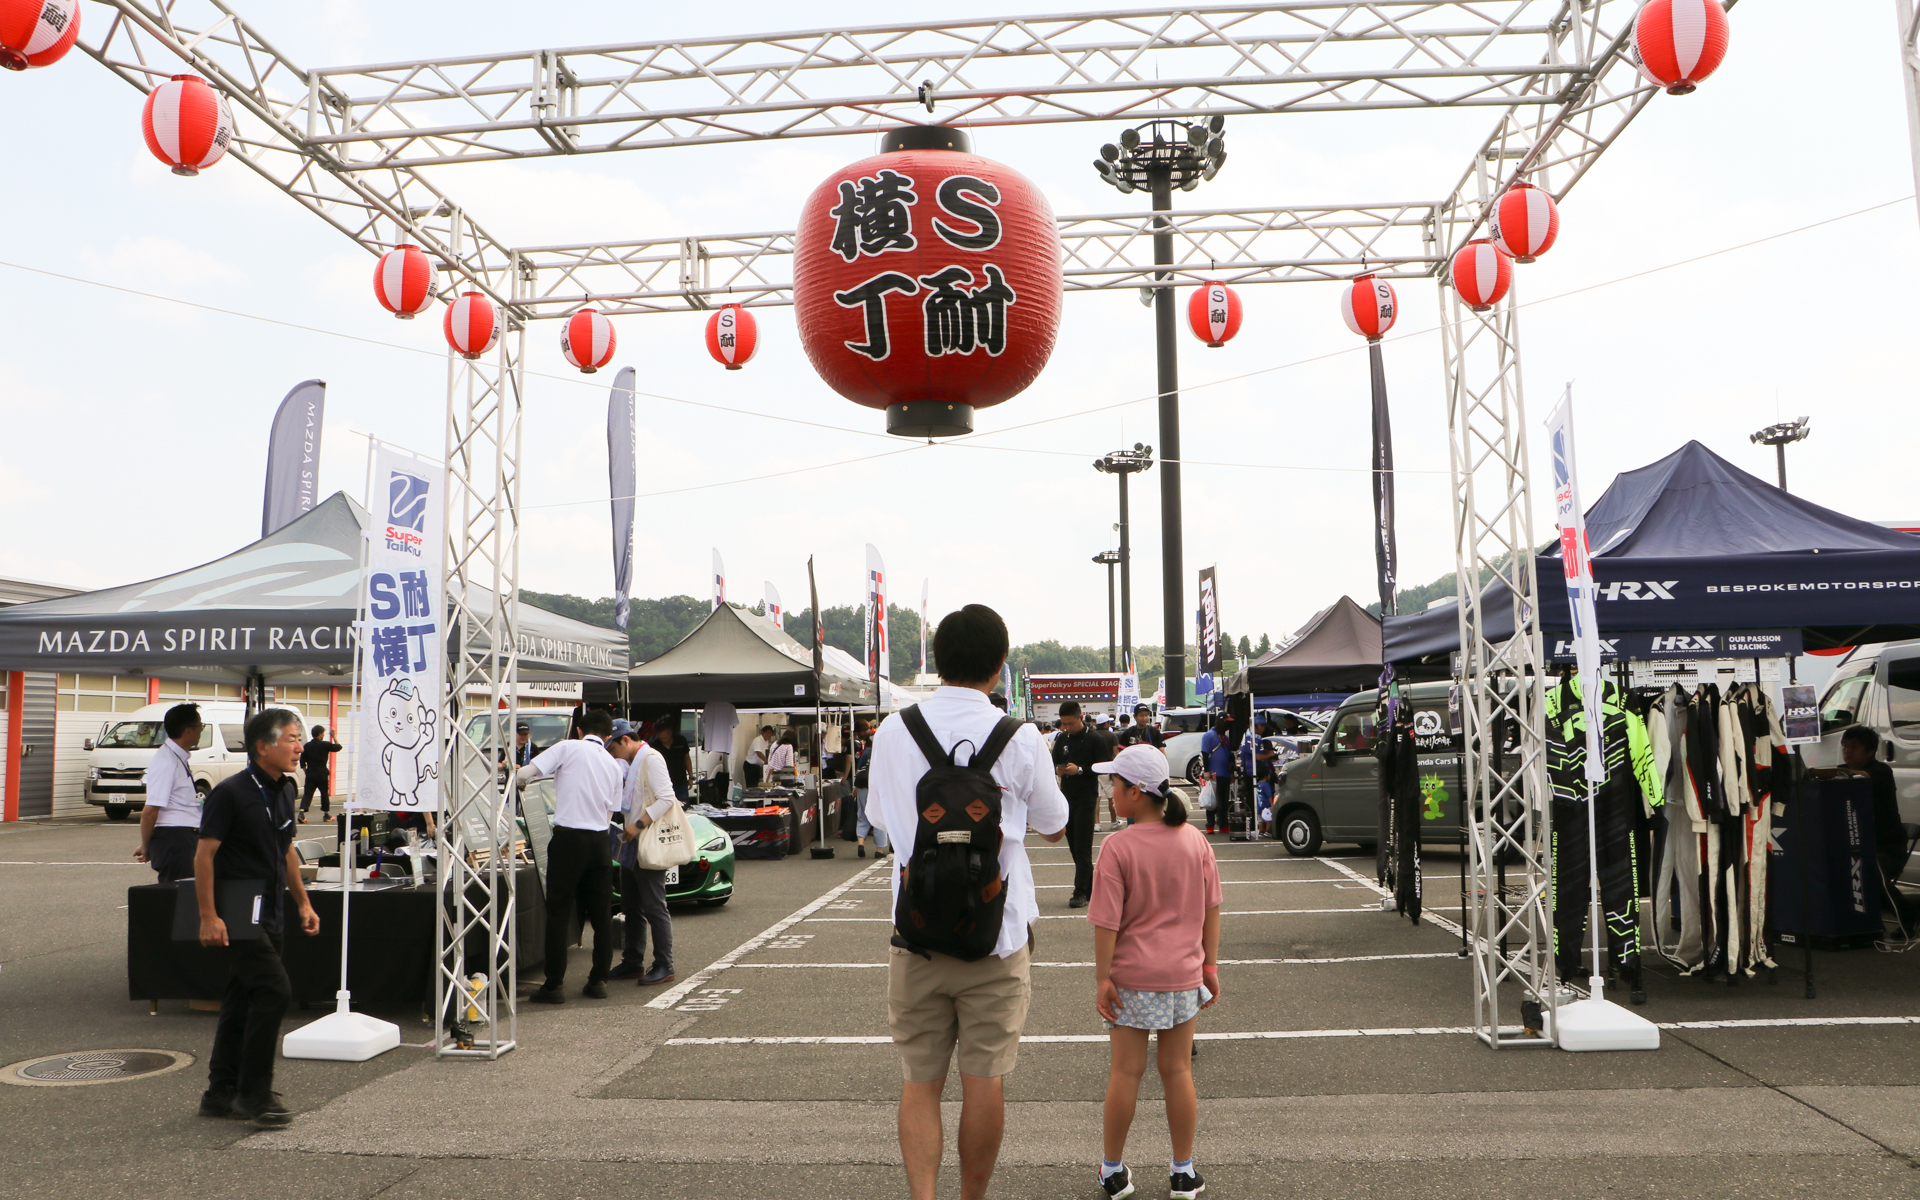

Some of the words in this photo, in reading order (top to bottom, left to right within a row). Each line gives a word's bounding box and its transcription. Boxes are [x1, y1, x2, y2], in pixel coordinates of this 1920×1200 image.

[829, 169, 920, 361] 横丁
[931, 175, 1017, 357] S耐
[1211, 290, 1226, 324] S耐
[720, 314, 736, 348] S耐
[303, 401, 316, 464] MAZDA
[301, 470, 313, 512] SPIRI
[385, 526, 423, 545] Super
[385, 538, 422, 557] Taikyu
[370, 569, 430, 620] S耐
[1593, 580, 1680, 601] HRX
[1707, 580, 1920, 593] BESPOKEMOTORSPOR
[38, 629, 151, 654] MAZDA
[163, 627, 256, 652] SPIRIT
[268, 626, 363, 651] RACIN
[371, 623, 436, 678] 横丁
[496, 630, 537, 657] ADA
[540, 638, 573, 662] SPIRIT
[576, 644, 613, 668] RACING
[1554, 638, 1621, 655] HX
[1651, 635, 1717, 650] HRX
[1738, 643, 1771, 651] RACING.
[1747, 635, 1781, 643] PASSION
[1073, 680, 1099, 688] SPECIAL
[1101, 680, 1120, 688] STAG
[1787, 706, 1817, 716] HRX
[1417, 758, 1434, 766] onda
[665, 872, 677, 883] 68
[1851, 856, 1866, 913] HRX
